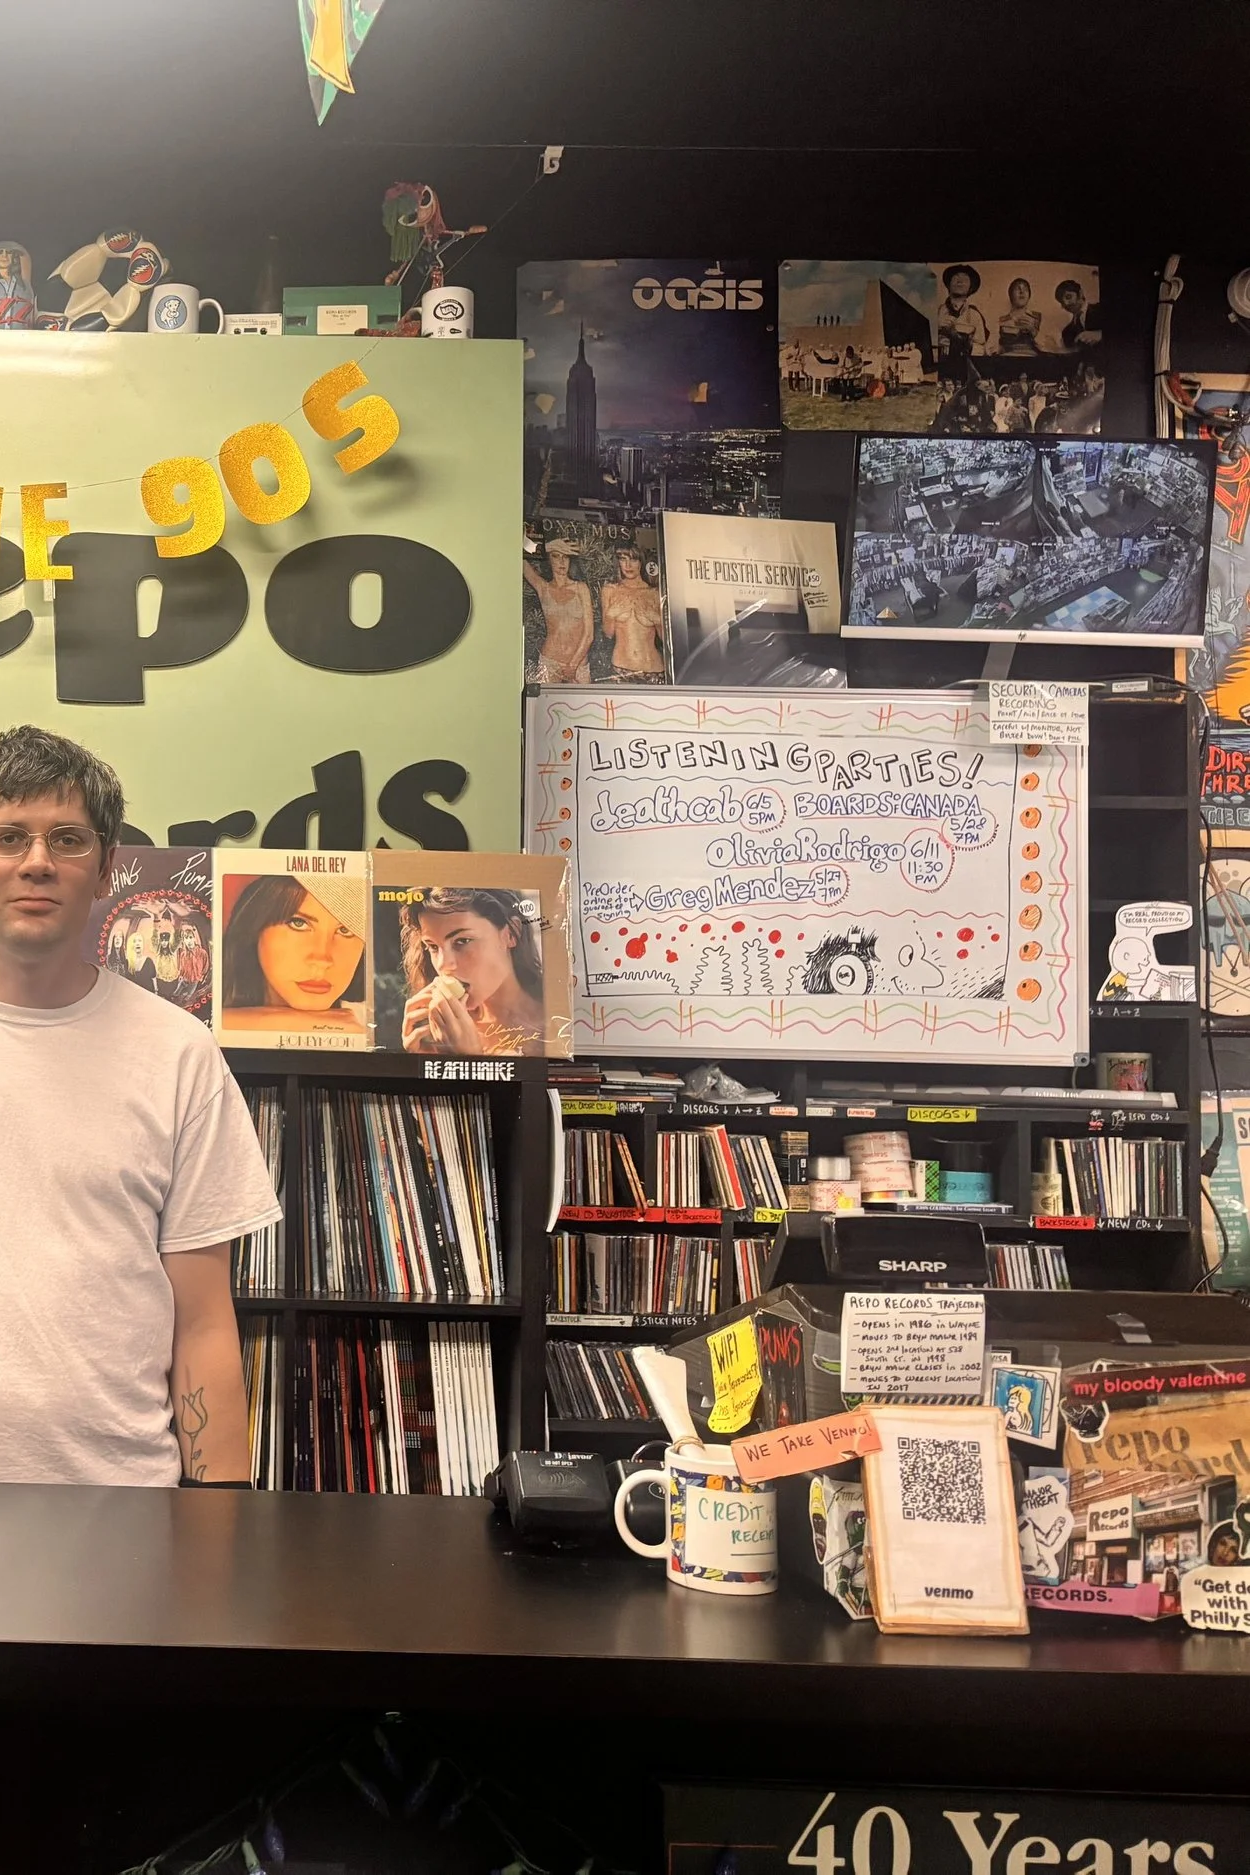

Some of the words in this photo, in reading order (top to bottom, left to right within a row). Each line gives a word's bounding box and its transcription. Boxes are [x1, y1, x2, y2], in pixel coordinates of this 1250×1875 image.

[686, 558, 711, 581] THE
[713, 561, 763, 585] POSTAL
[765, 564, 814, 588] SERVIC
[998, 698, 1057, 711] RECORDING
[813, 748, 984, 790] PARTIES!
[746, 793, 773, 812] 6/5
[794, 791, 894, 818] BOARDS
[899, 792, 983, 818] CANADA
[748, 811, 776, 825] 5PM
[950, 816, 987, 832] 5/28
[1207, 805, 1242, 827] THE
[953, 832, 980, 845] 7PM
[798, 826, 906, 873] Rodrigo
[909, 836, 941, 861] 6/11
[285, 856, 311, 873] LANA
[312, 856, 329, 873] DEL
[329, 857, 347, 874] REY
[907, 860, 944, 875] 11:30
[914, 873, 938, 885] PM
[378, 889, 425, 905] mojo
[644, 884, 714, 912] Greg
[714, 866, 817, 906] Mendez
[683, 1104, 720, 1114] DISCOGS
[910, 1109, 960, 1120] DISCOGS
[1039, 1218, 1081, 1228] BACKSTOCK
[1107, 1219, 1131, 1229] NEW
[1135, 1219, 1151, 1230] CDs
[879, 1259, 947, 1273] SHARP
[884, 1296, 933, 1309] RECORDS
[641, 1315, 668, 1327] STICKY
[671, 1316, 698, 1326] NOTES
[909, 1320, 933, 1329] 1986
[948, 1320, 981, 1331] WAYNE
[713, 1330, 739, 1375] WIFI
[1074, 1381, 1099, 1397] my
[1104, 1376, 1166, 1395] bloody
[1169, 1370, 1247, 1390] valentine
[744, 1444, 769, 1463] WE
[777, 1434, 816, 1456] TAKE
[820, 1417, 873, 1446] VENMO!
[1081, 1426, 1191, 1466] repo
[1024, 1484, 1052, 1500] MAJOR
[1022, 1492, 1060, 1510] THREAT
[924, 1586, 974, 1600] venmo
[1207, 1596, 1249, 1611] with
[1190, 1610, 1240, 1628] Philly
[786, 1791, 912, 1875] 40
[941, 1811, 1217, 1875] Years
